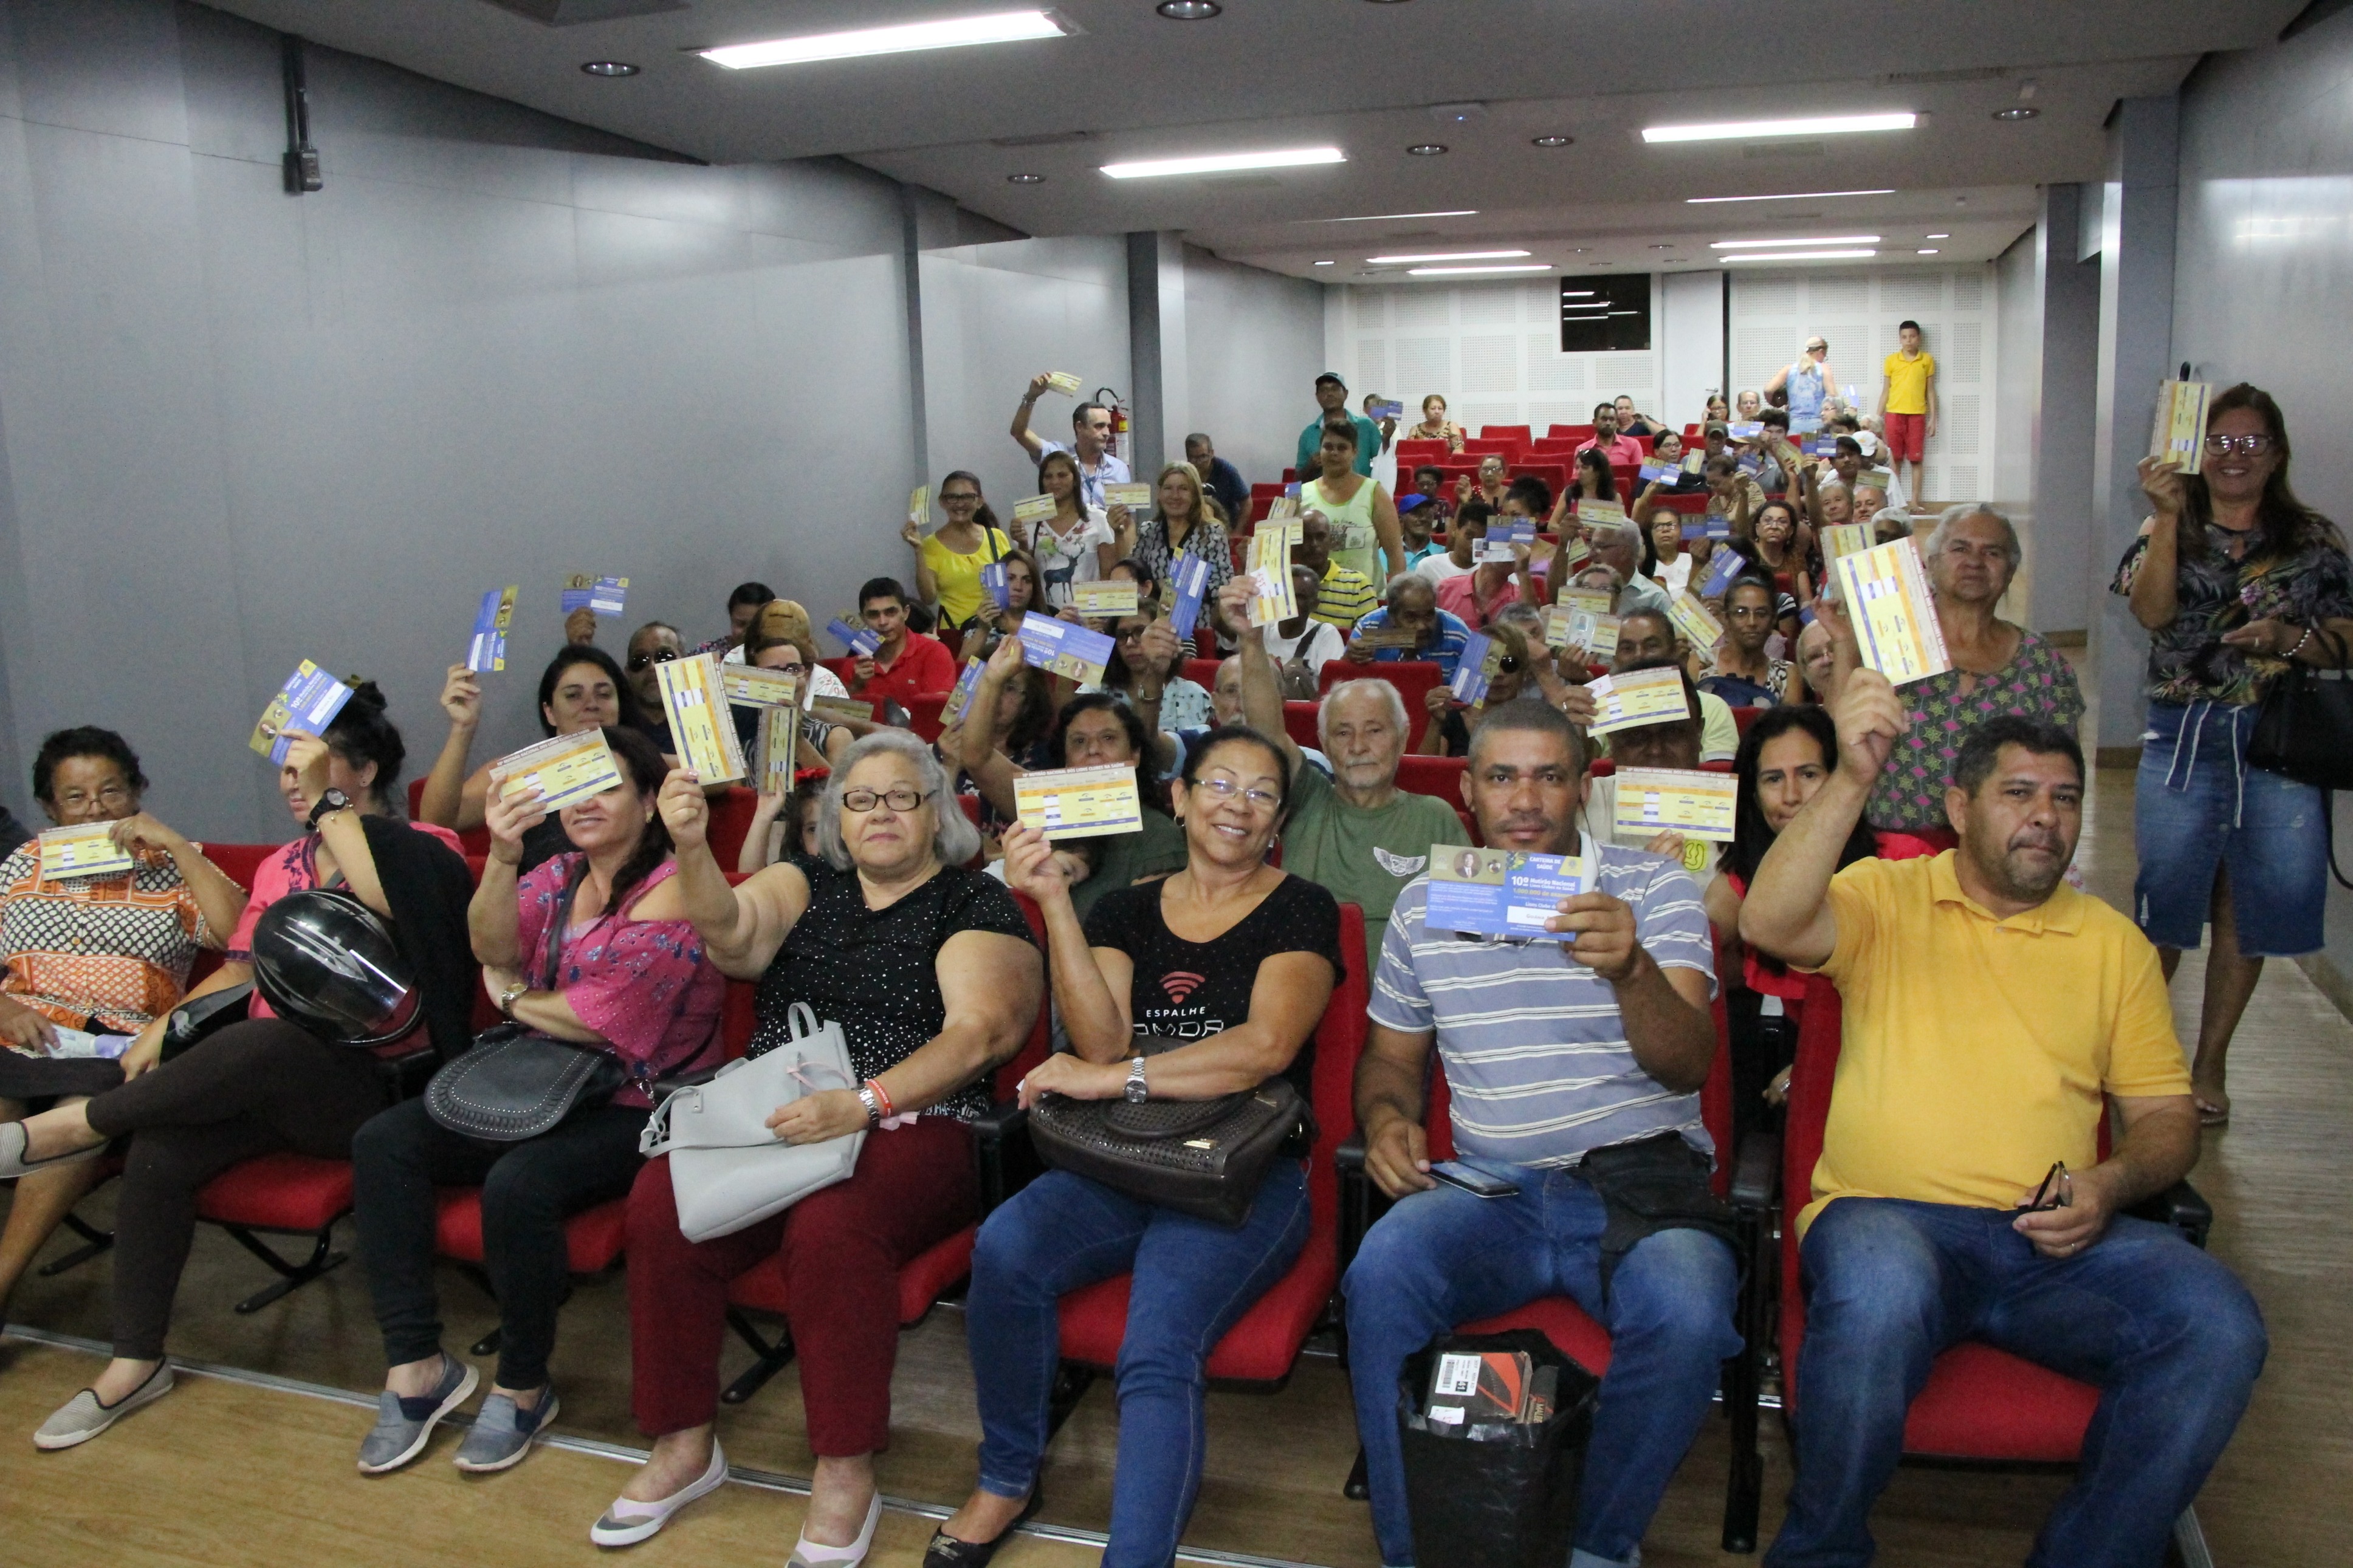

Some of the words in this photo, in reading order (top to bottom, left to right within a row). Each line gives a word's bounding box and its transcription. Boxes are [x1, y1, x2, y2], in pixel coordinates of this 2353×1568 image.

[1511, 875, 1529, 886] 10º
[1146, 1006, 1206, 1018] ESPALHE
[1457, 1381, 1467, 1391] 41
